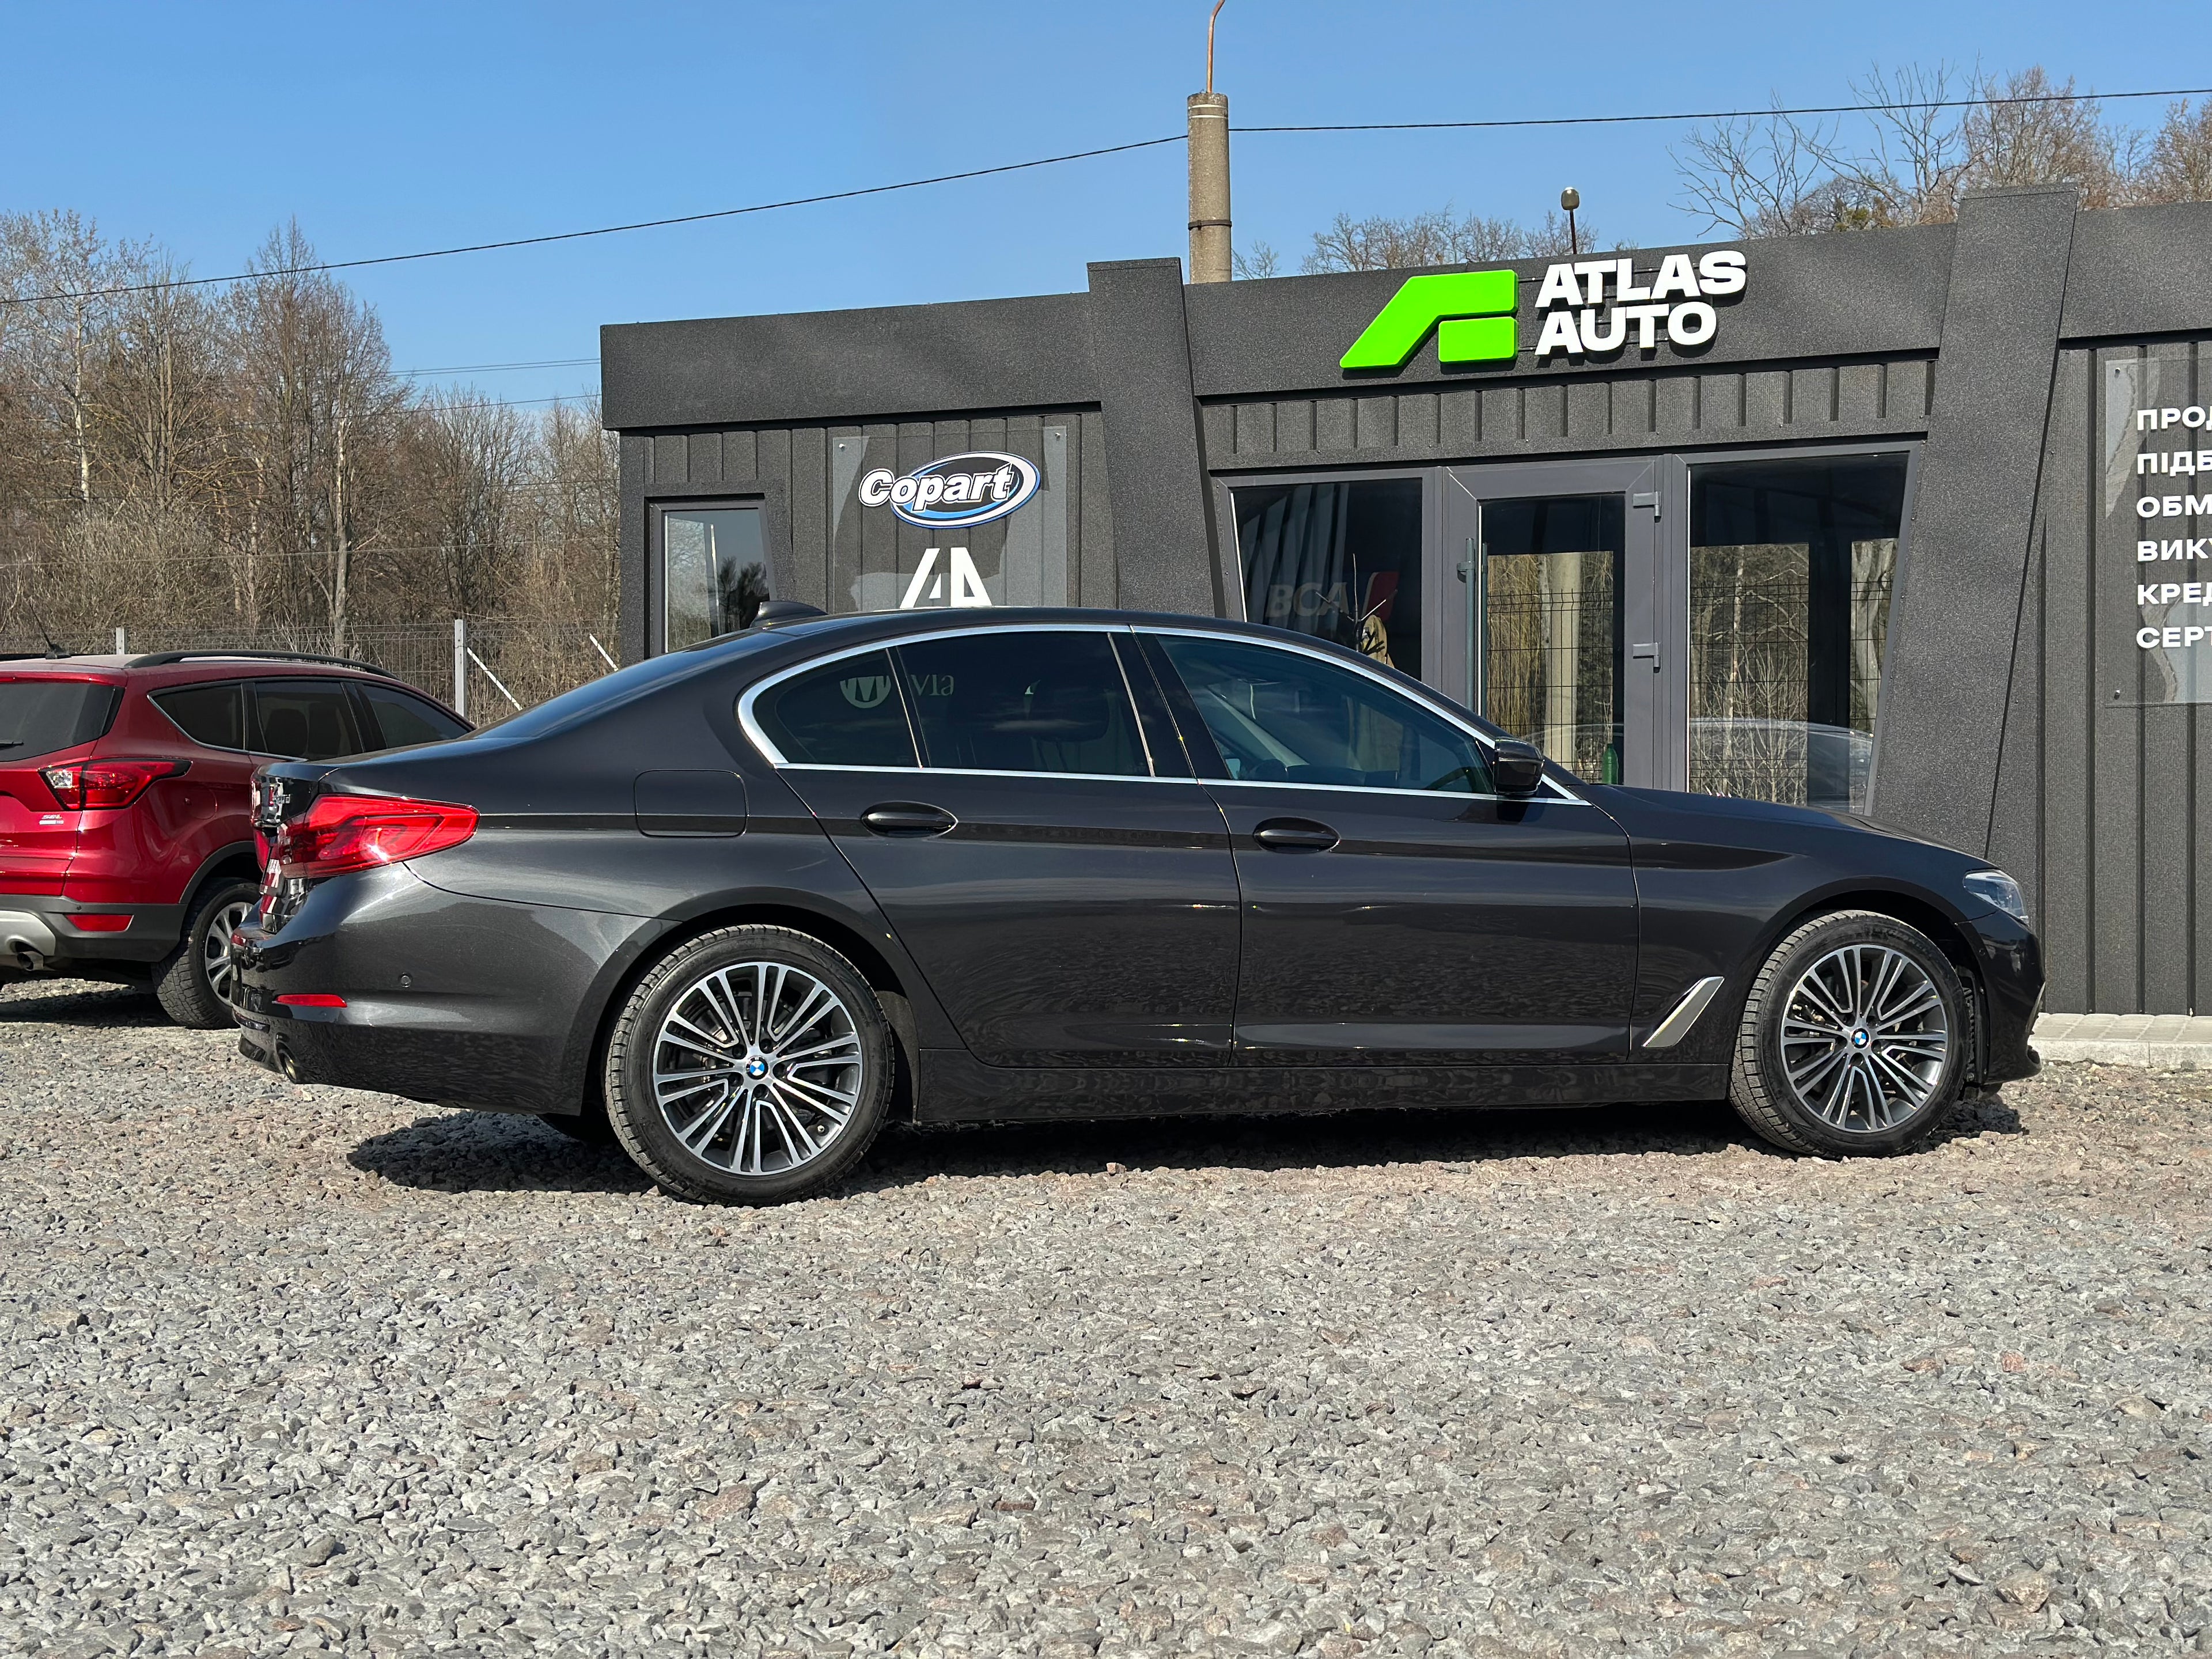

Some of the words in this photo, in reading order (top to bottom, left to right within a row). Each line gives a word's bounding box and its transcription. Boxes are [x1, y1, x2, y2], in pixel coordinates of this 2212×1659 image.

[1535, 250, 1747, 308] ATLAS
[1534, 301, 1717, 355] AUTO
[2137, 406, 2212, 431] ПРО
[858, 462, 1014, 513] Copart
[2137, 538, 2212, 562] ВИК
[1266, 582, 1350, 617] BCA
